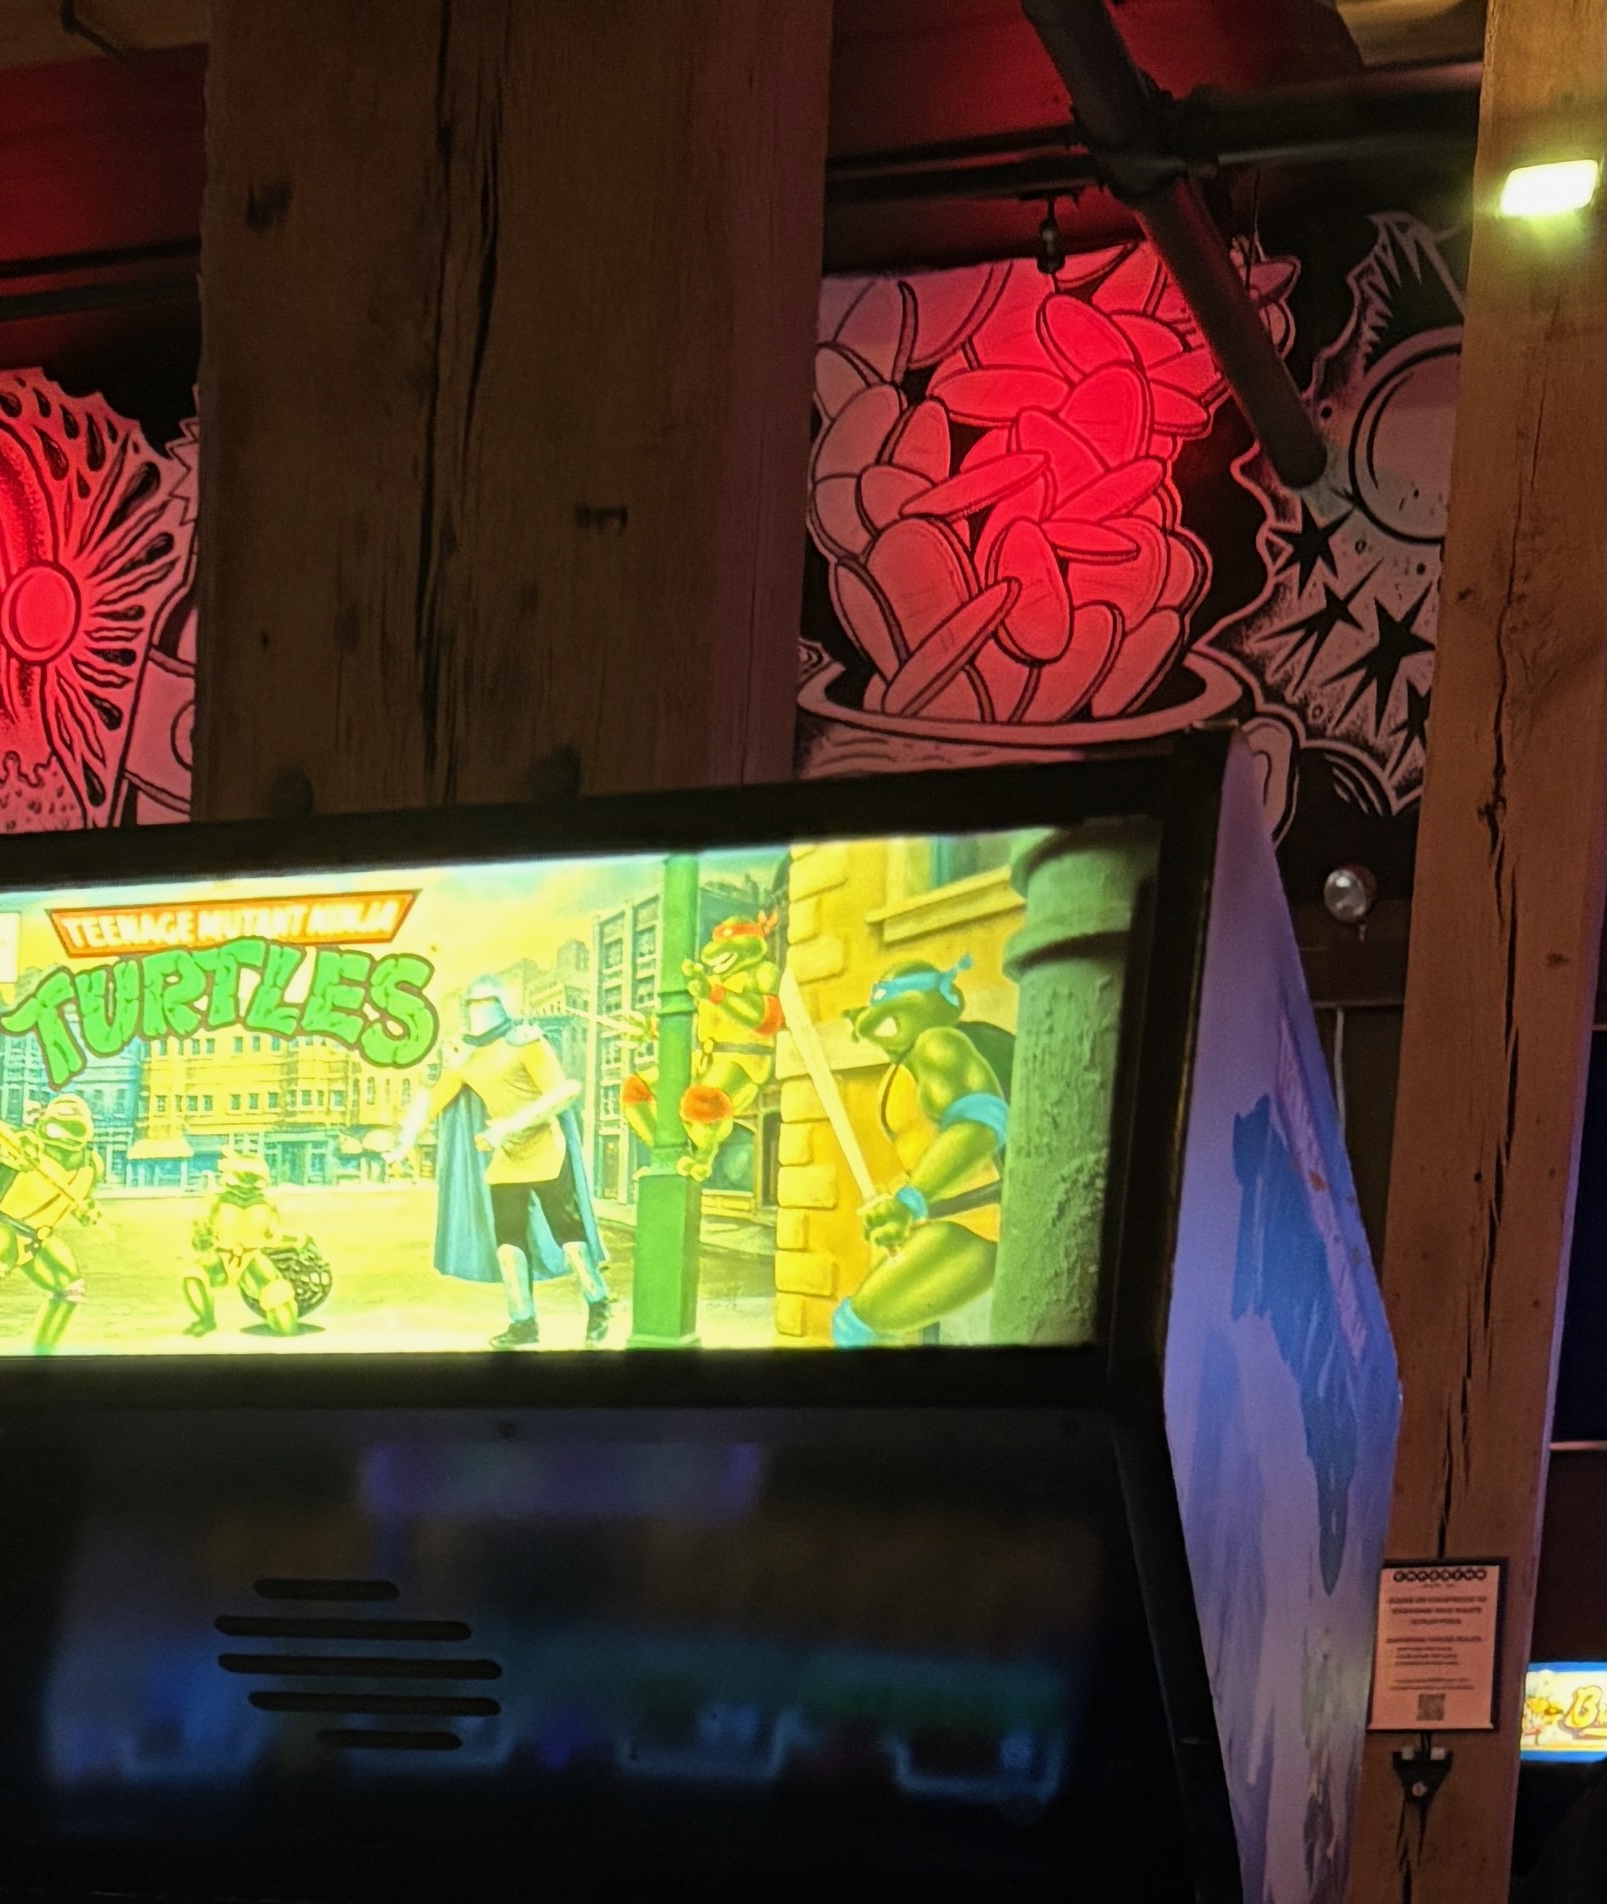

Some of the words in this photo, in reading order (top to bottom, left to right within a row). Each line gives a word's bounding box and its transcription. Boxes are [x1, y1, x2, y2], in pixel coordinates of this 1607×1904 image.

[64, 909, 195, 949] TEENAGE
[198, 901, 305, 942] MUTANT
[306, 897, 397, 937] NINJA
[1, 938, 438, 1090] TURTLES
